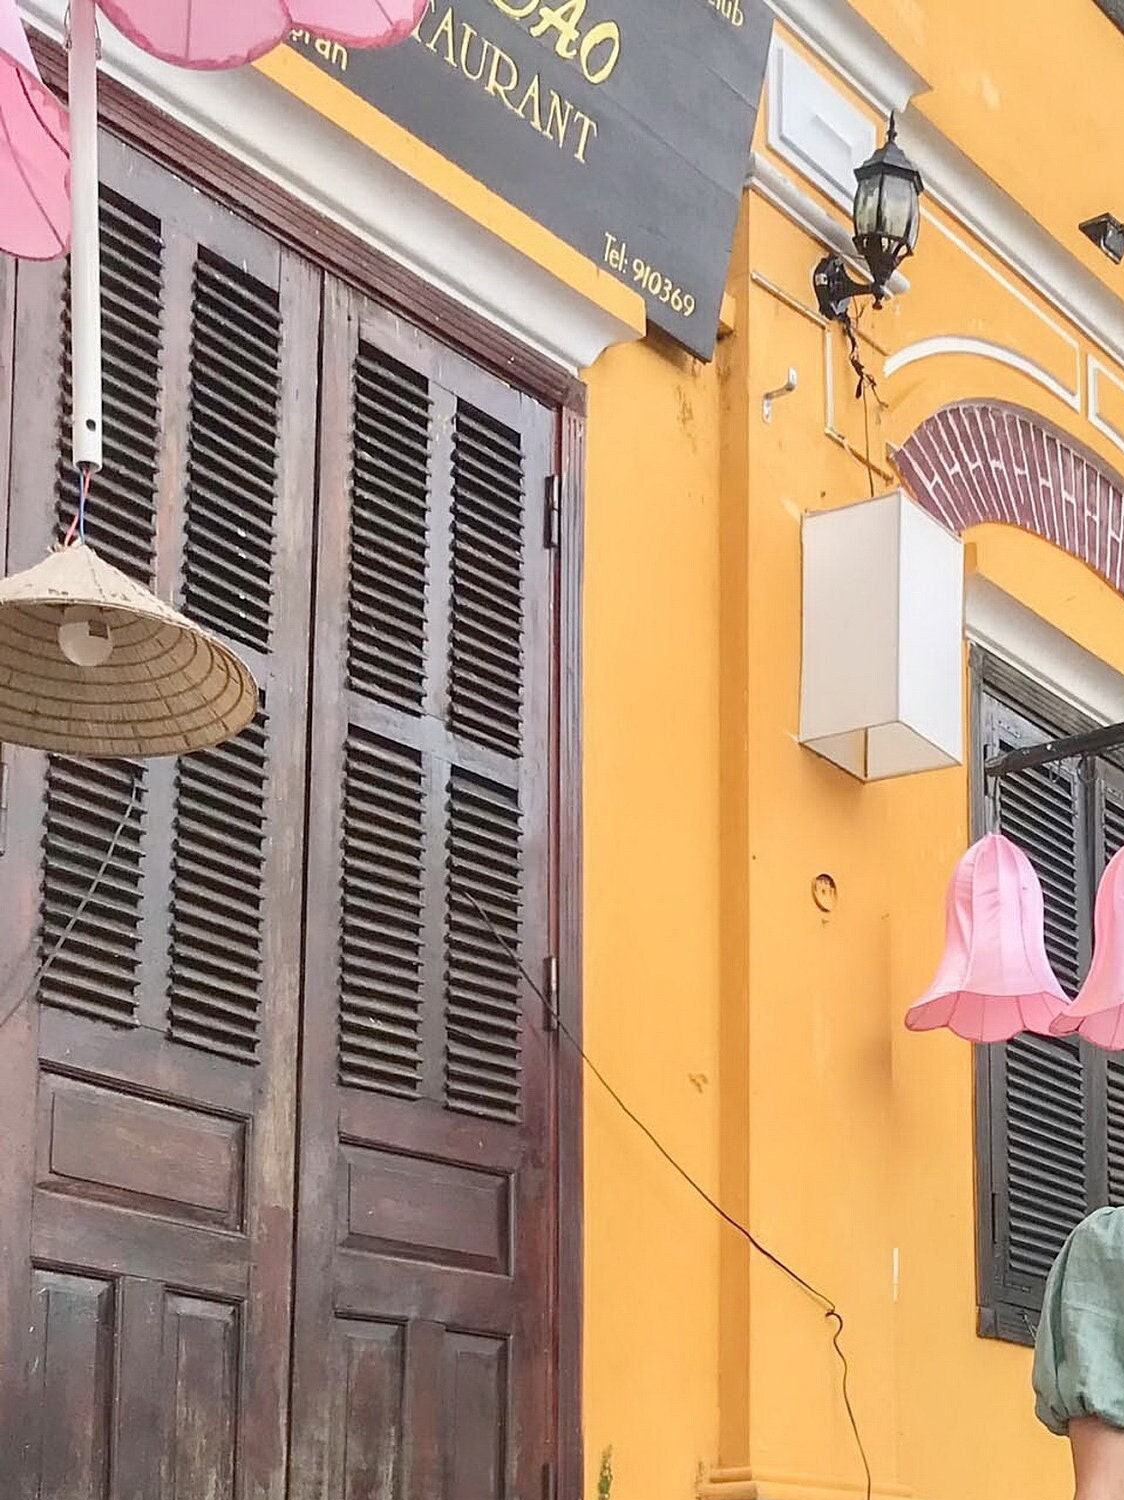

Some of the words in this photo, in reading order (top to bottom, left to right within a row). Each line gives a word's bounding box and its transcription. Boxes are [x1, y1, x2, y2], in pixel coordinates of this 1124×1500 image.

[493, 0, 621, 84] AO
[604, 231, 628, 274] Tel:
[632, 258, 695, 317] 910369
